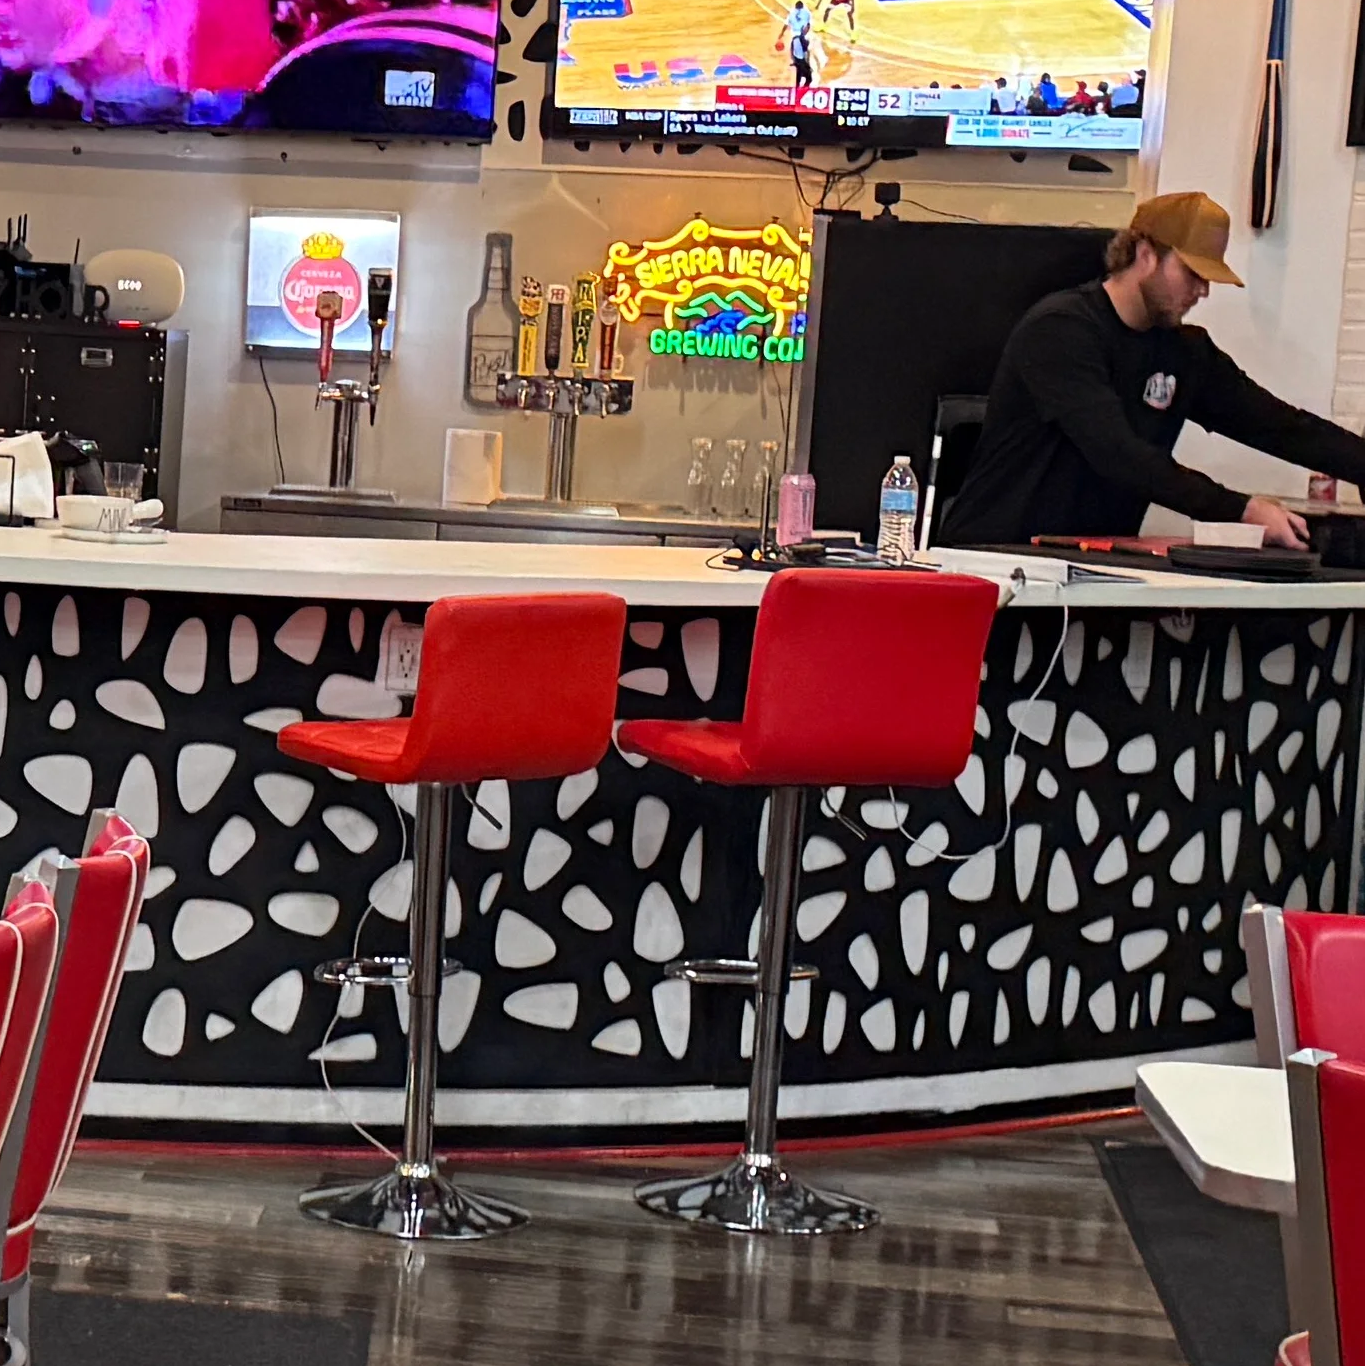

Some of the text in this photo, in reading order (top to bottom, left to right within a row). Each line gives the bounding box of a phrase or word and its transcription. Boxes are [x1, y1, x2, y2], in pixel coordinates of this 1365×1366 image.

[613, 54, 761, 84] USA
[799, 89, 829, 110] 40
[877, 94, 901, 109] 52
[300, 269, 342, 279] CERVEZA
[635, 246, 800, 292] SIERRA NEVA
[650, 328, 758, 360] BREWING
